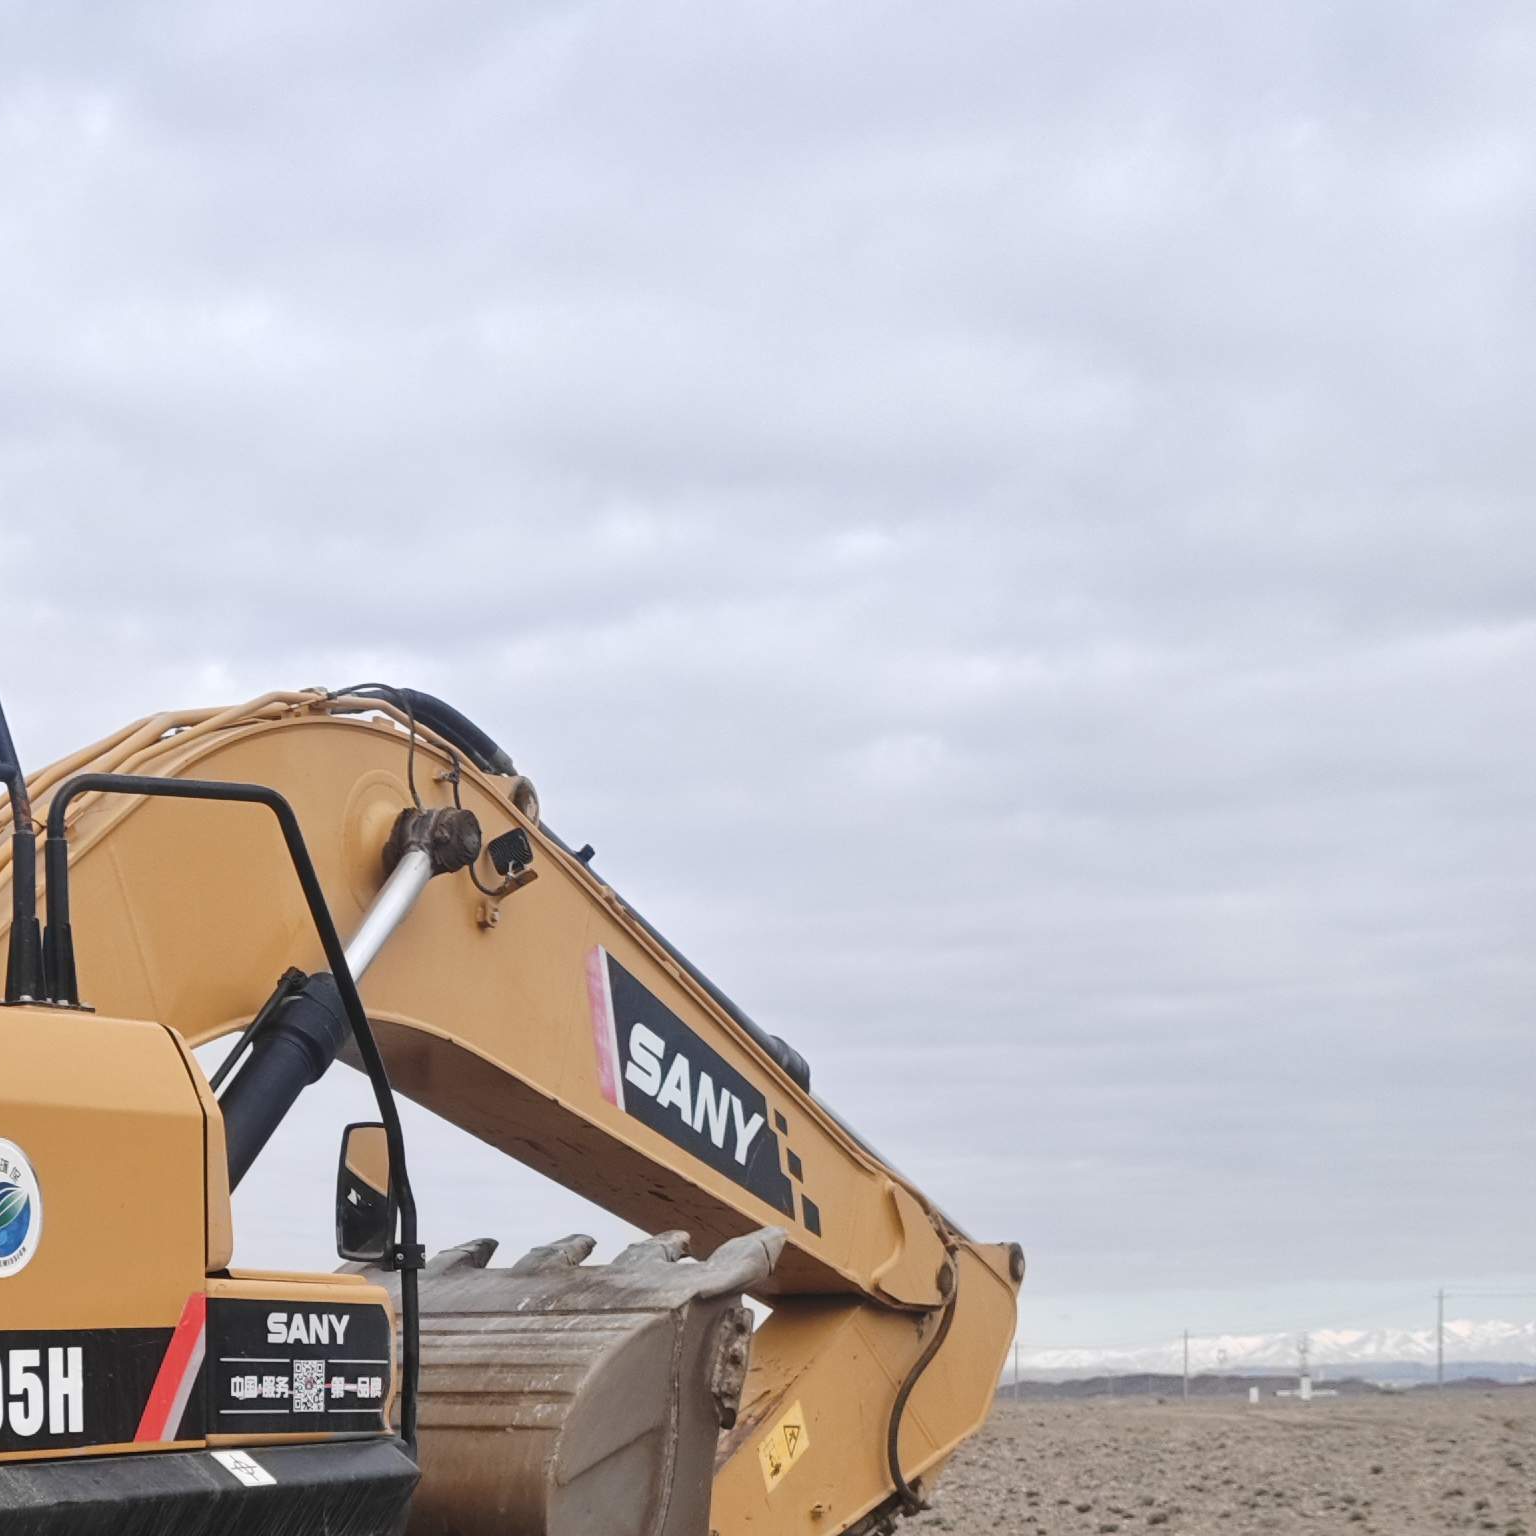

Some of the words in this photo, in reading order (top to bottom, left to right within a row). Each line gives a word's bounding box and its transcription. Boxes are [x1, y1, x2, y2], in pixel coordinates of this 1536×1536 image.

[625, 1022, 764, 1166] SANY
[267, 1312, 350, 1345] SANY
[330, 1375, 382, 1400] 第一品牌
